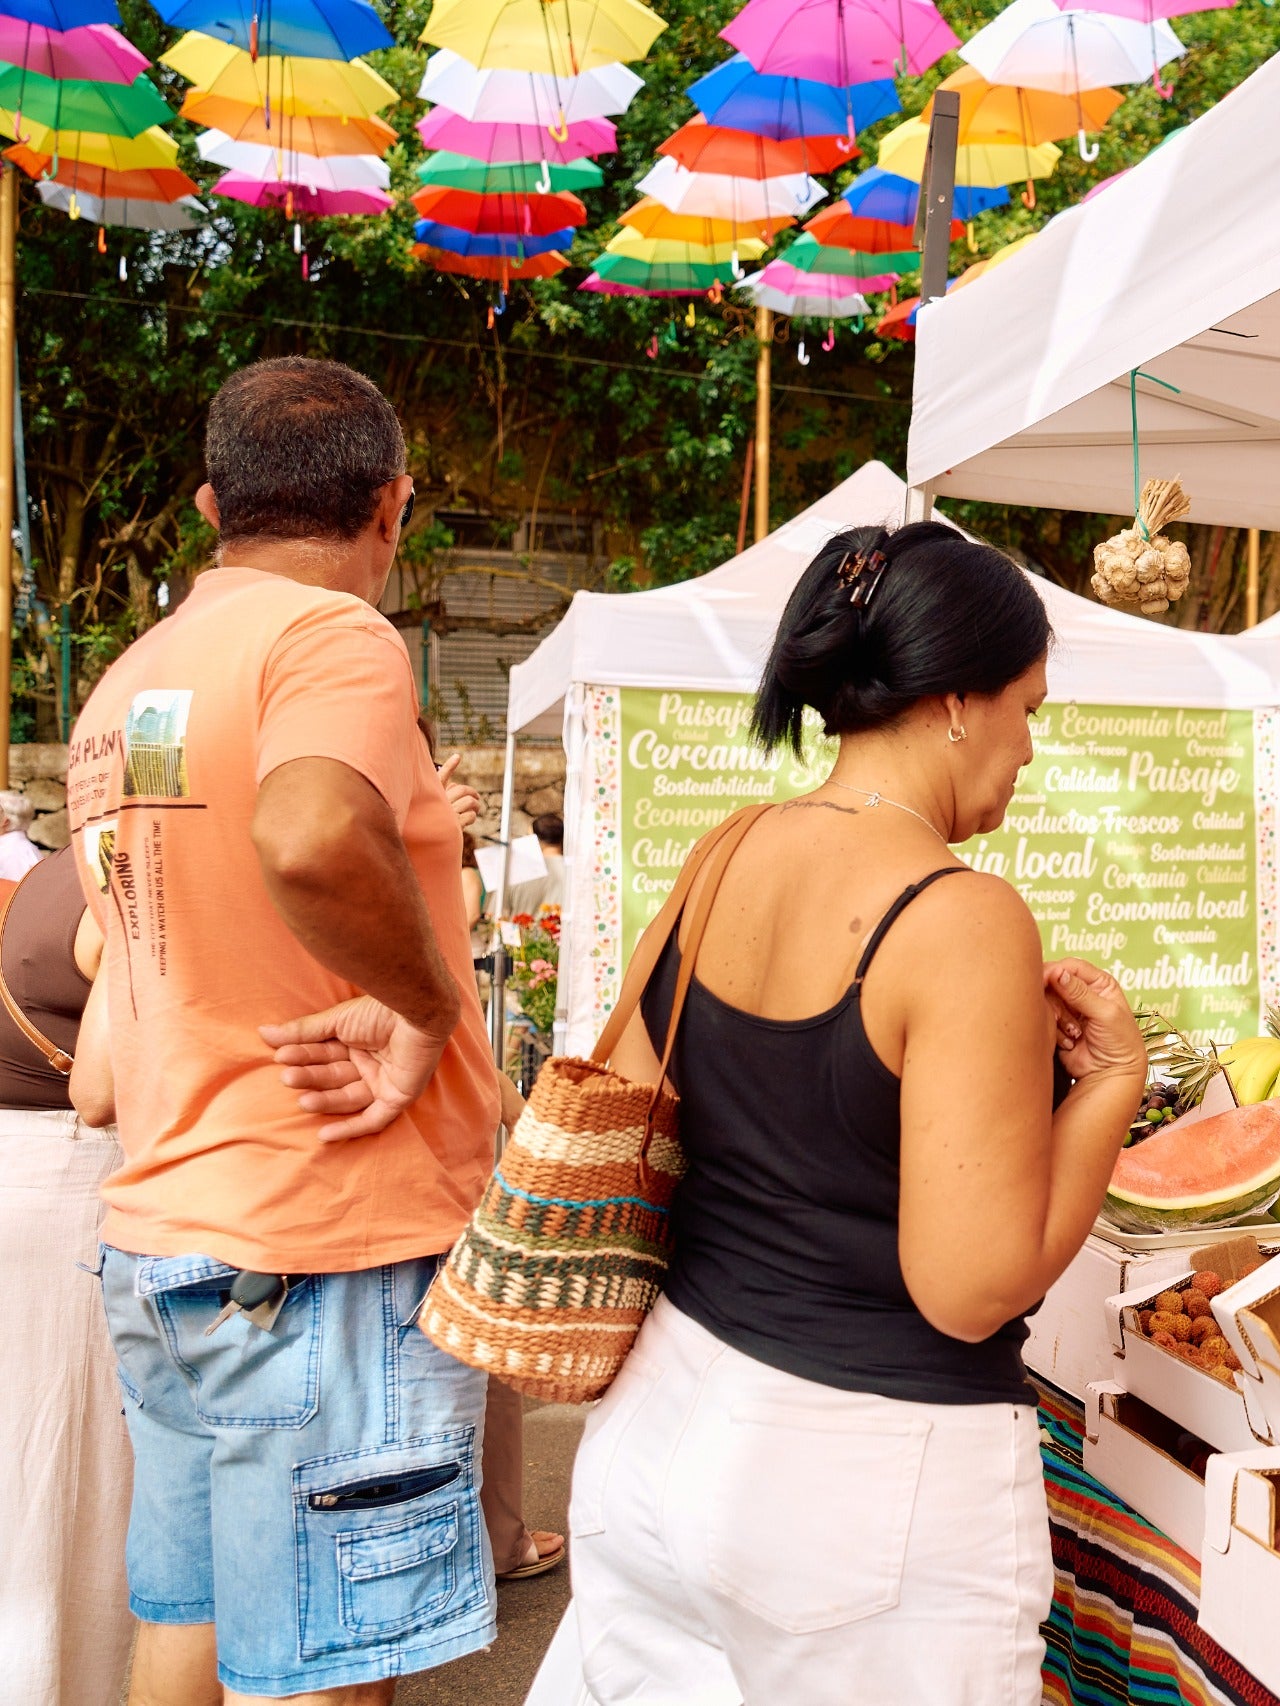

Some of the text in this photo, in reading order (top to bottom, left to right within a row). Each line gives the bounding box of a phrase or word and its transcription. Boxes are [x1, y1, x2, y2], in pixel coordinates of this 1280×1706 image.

[1061, 705, 1171, 738] Economía
[1175, 709, 1228, 738] local
[652, 774, 777, 797] Sostenibilidad
[1044, 766, 1122, 793] Calidad
[1127, 750, 1241, 807] Paisaje
[152, 820, 161, 838] TIME
[1003, 805, 1184, 834] roductos Frescos
[1192, 811, 1246, 831] Calidad
[153, 841, 162, 856] THE
[631, 838, 696, 868] Calid
[1014, 836, 1098, 880] local
[1150, 842, 1247, 862] Sostenibilidad
[154, 859, 163, 875] ALL
[1103, 863, 1189, 889] Cercanía
[1196, 865, 1248, 884] Calidad
[114, 852, 139, 939] EXPLORING
[155, 877, 163, 888] US
[156, 889, 164, 901] ON
[156, 903, 165, 931] WATCH
[1086, 889, 1249, 926] Economía local
[1051, 924, 1128, 959] Paisaje
[158, 942, 167, 976] KEEPING
[1108, 952, 1254, 991] tenibilidad
